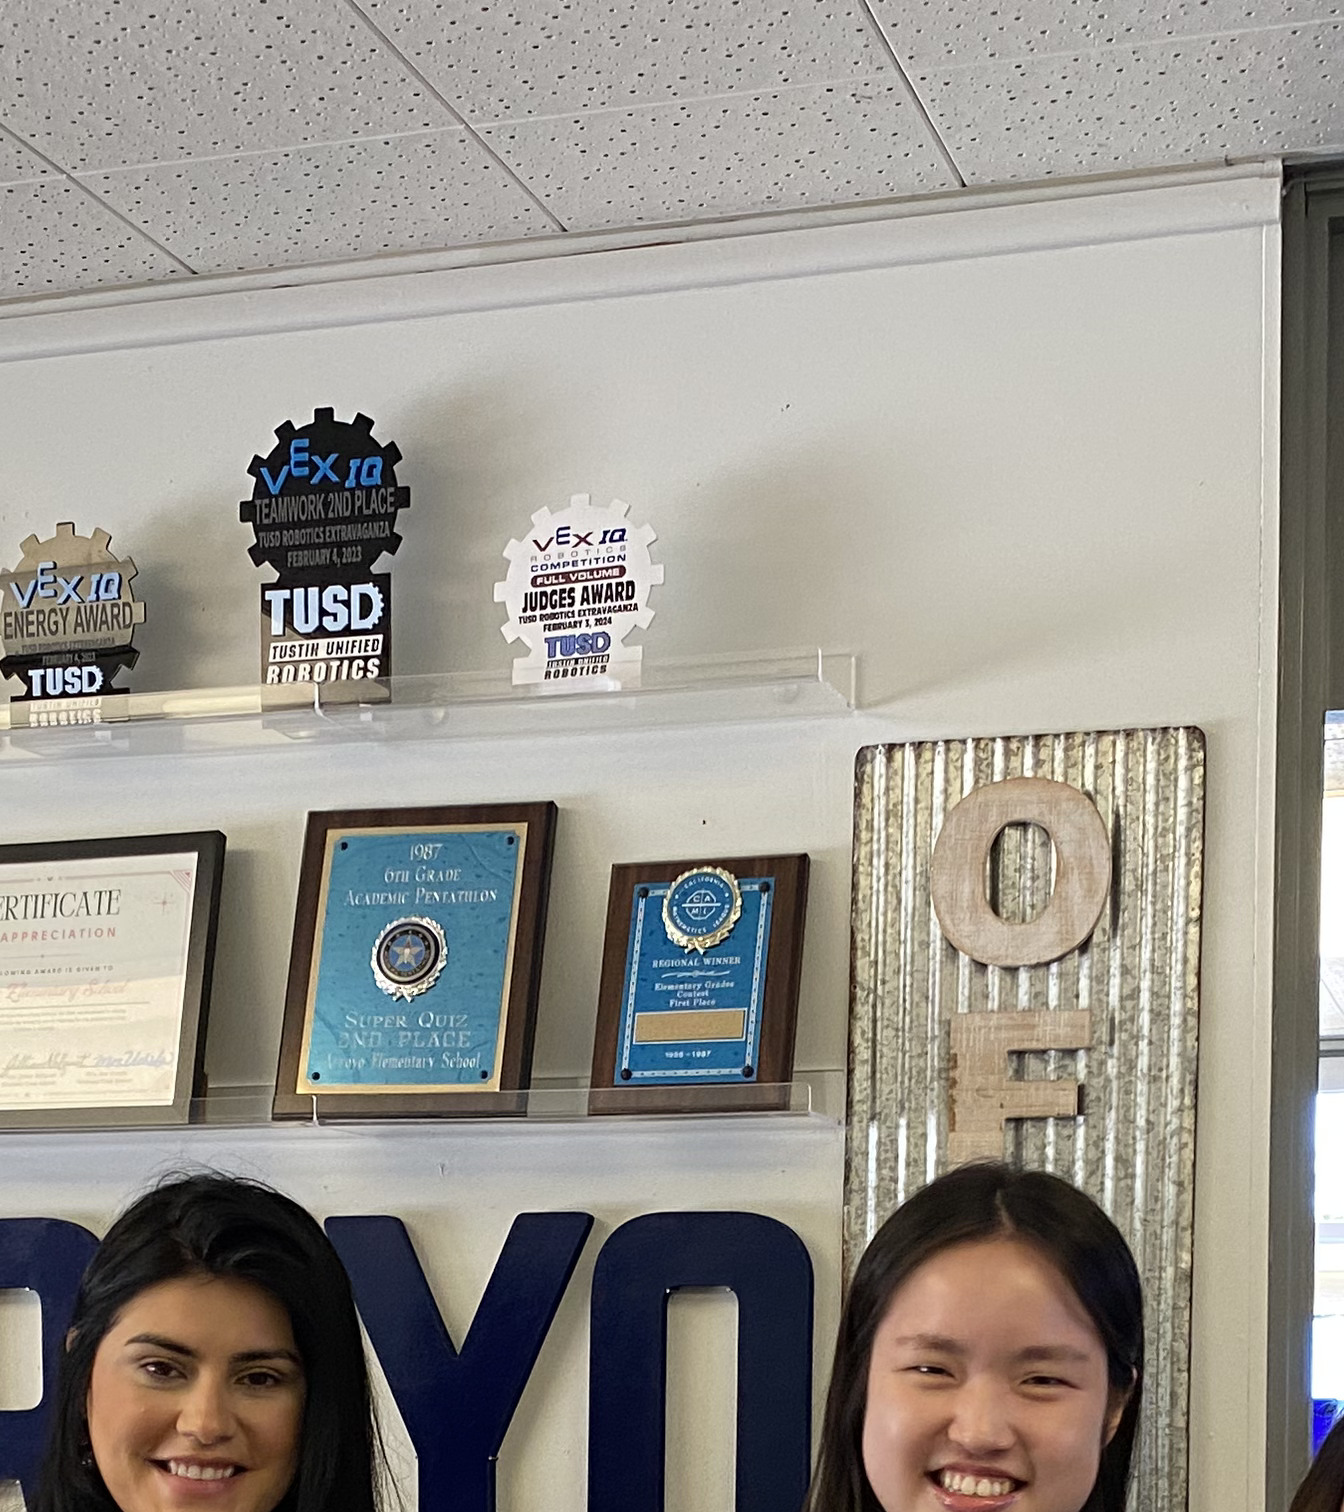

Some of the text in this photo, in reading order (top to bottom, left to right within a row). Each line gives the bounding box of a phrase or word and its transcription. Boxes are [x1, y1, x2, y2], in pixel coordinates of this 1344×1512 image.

[260, 438, 383, 495] VEX IQ
[255, 487, 395, 525] TEAMWORK 2ND PLACE
[258, 521, 390, 548] TUSD ROBOTICS EXTRAVAGANZA
[532, 526, 628, 551] VEX IQ
[288, 546, 362, 567] FEBRUARY 4, 2023
[530, 544, 626, 562] ROBOTICS
[531, 554, 626, 573] COMPETITION
[10, 561, 122, 608] VEX IQ
[536, 567, 620, 585] FULL VOLUME
[522, 580, 636, 614] JUDGES AWARD
[265, 582, 384, 636] TUSD
[518, 603, 638, 625] TUSD ROBOTICS EXTRAVAGANZA
[3, 601, 134, 640] ENERGY AWARD
[543, 620, 582, 633] FEBRUARY
[271, 637, 380, 660] TUSTIN UNIFIED
[544, 631, 611, 659] TUSD
[28, 665, 103, 696] TUSD
[266, 658, 381, 685] ROBOTICS
[544, 665, 607, 680] ROBOTICS
[410, 843, 443, 861] 1987
[0, 927, 117, 943] APPRECIATION
[652, 956, 741, 968] REGIONAL WINNER
[654, 980, 735, 991] Elementary Grades
[677, 990, 709, 998] Contest
[669, 998, 716, 1007] First Place
[344, 1011, 468, 1028] SUPER QUIZ
[338, 1031, 472, 1049] 2ND PLACE
[370, 1052, 436, 1070] Elementary
[441, 1052, 481, 1069] School
